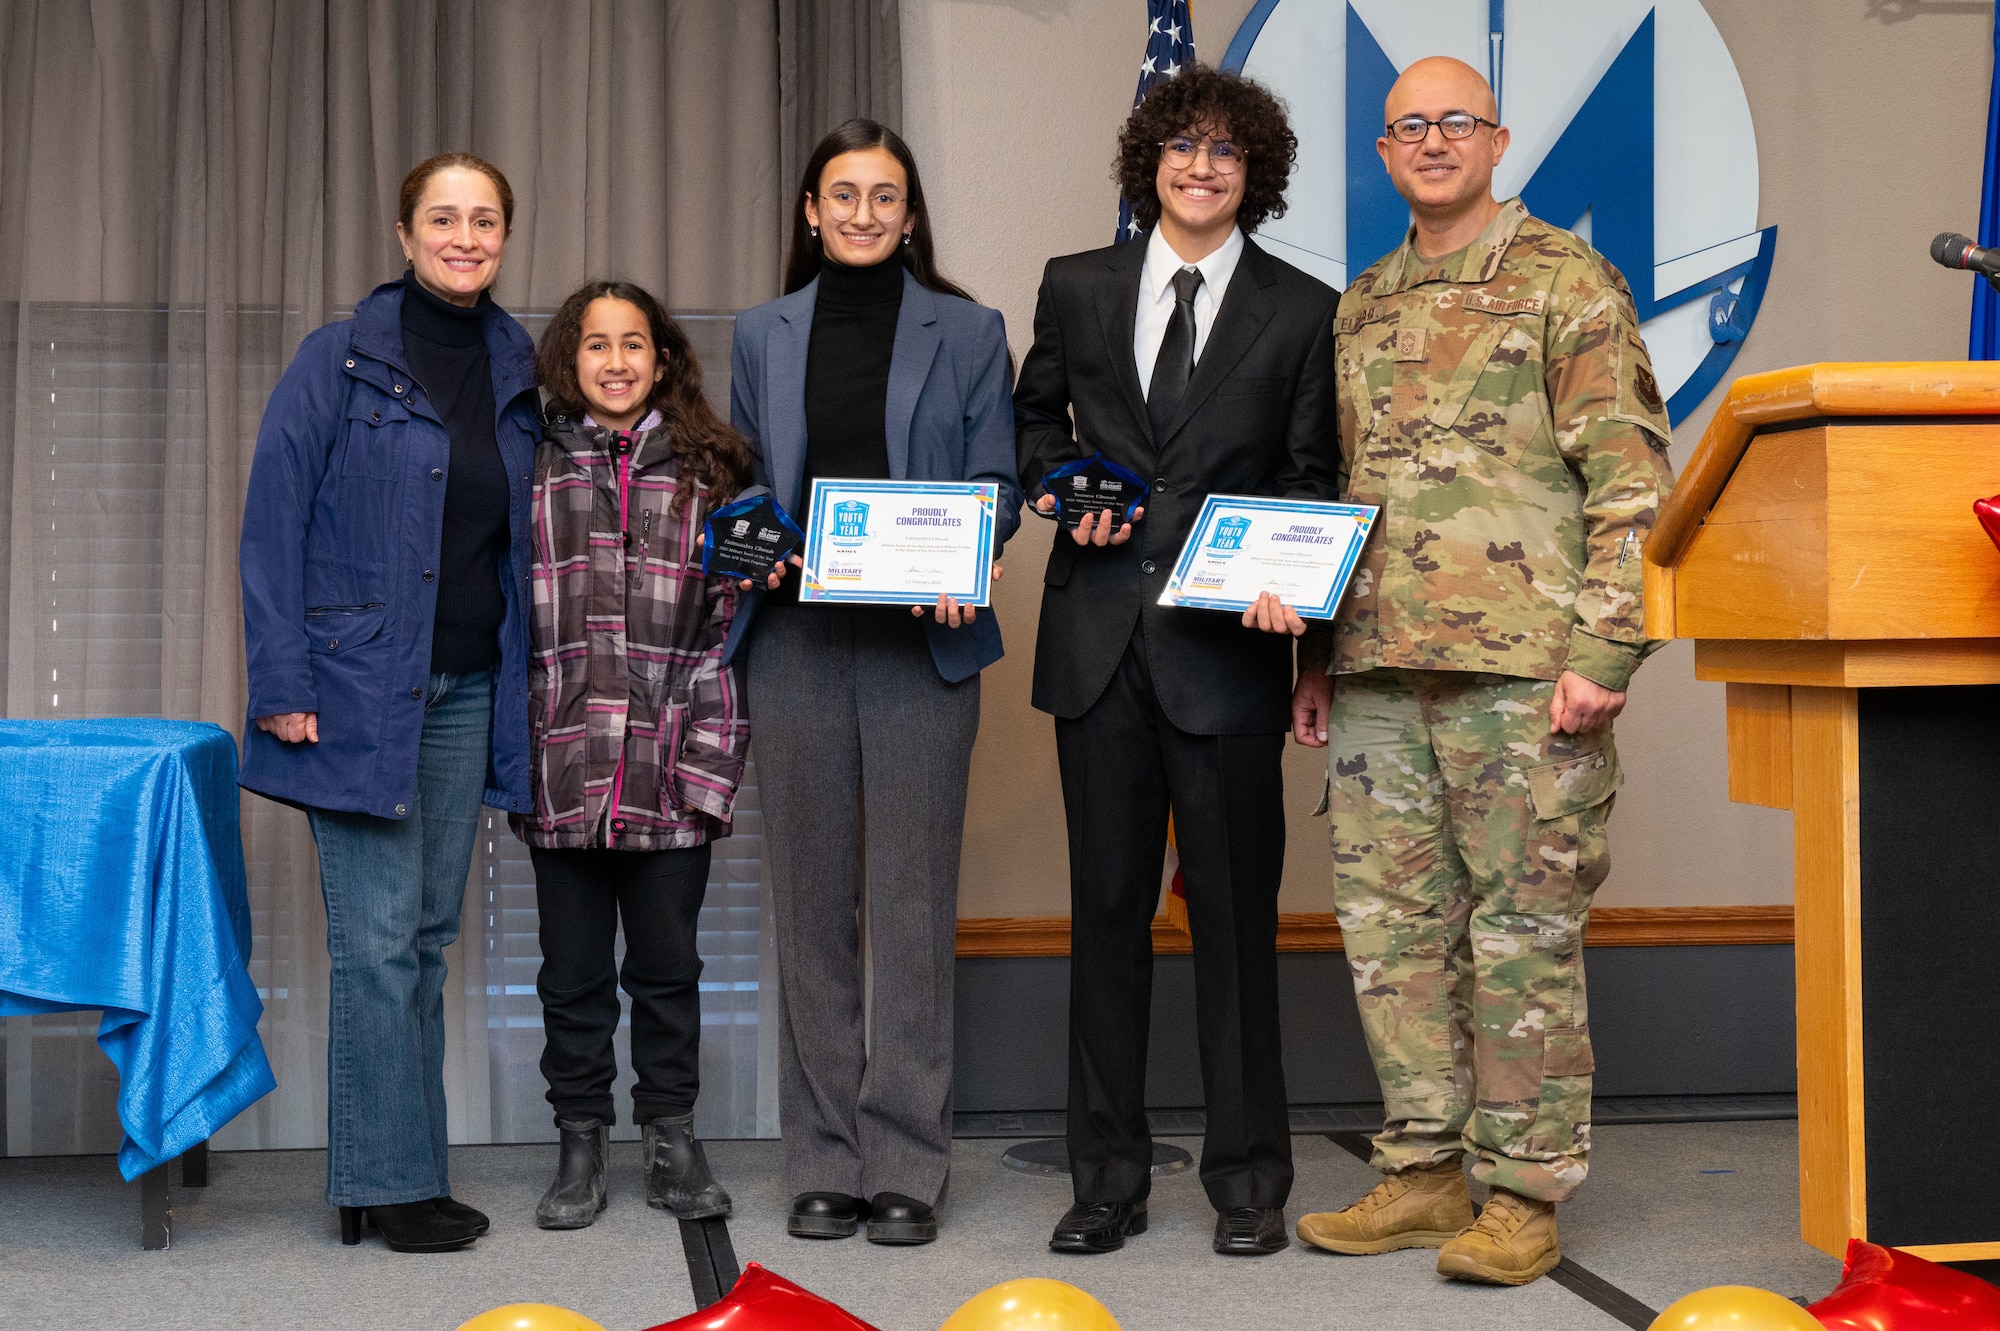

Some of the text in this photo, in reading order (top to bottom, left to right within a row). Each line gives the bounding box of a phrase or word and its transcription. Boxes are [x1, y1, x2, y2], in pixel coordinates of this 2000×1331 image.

[1466, 294, 1540, 312] U.S. AIR FORCE
[912, 508, 948, 516] PROUDLY
[839, 512, 863, 523] YOUTH
[896, 517, 962, 526] CONGRATULATES
[840, 525, 859, 536] YEAR
[1219, 527, 1243, 537] YOUTH
[1289, 525, 1324, 534] PROUDLY
[1216, 538, 1235, 548] YEAR
[1271, 533, 1334, 544] CONGRATULATES
